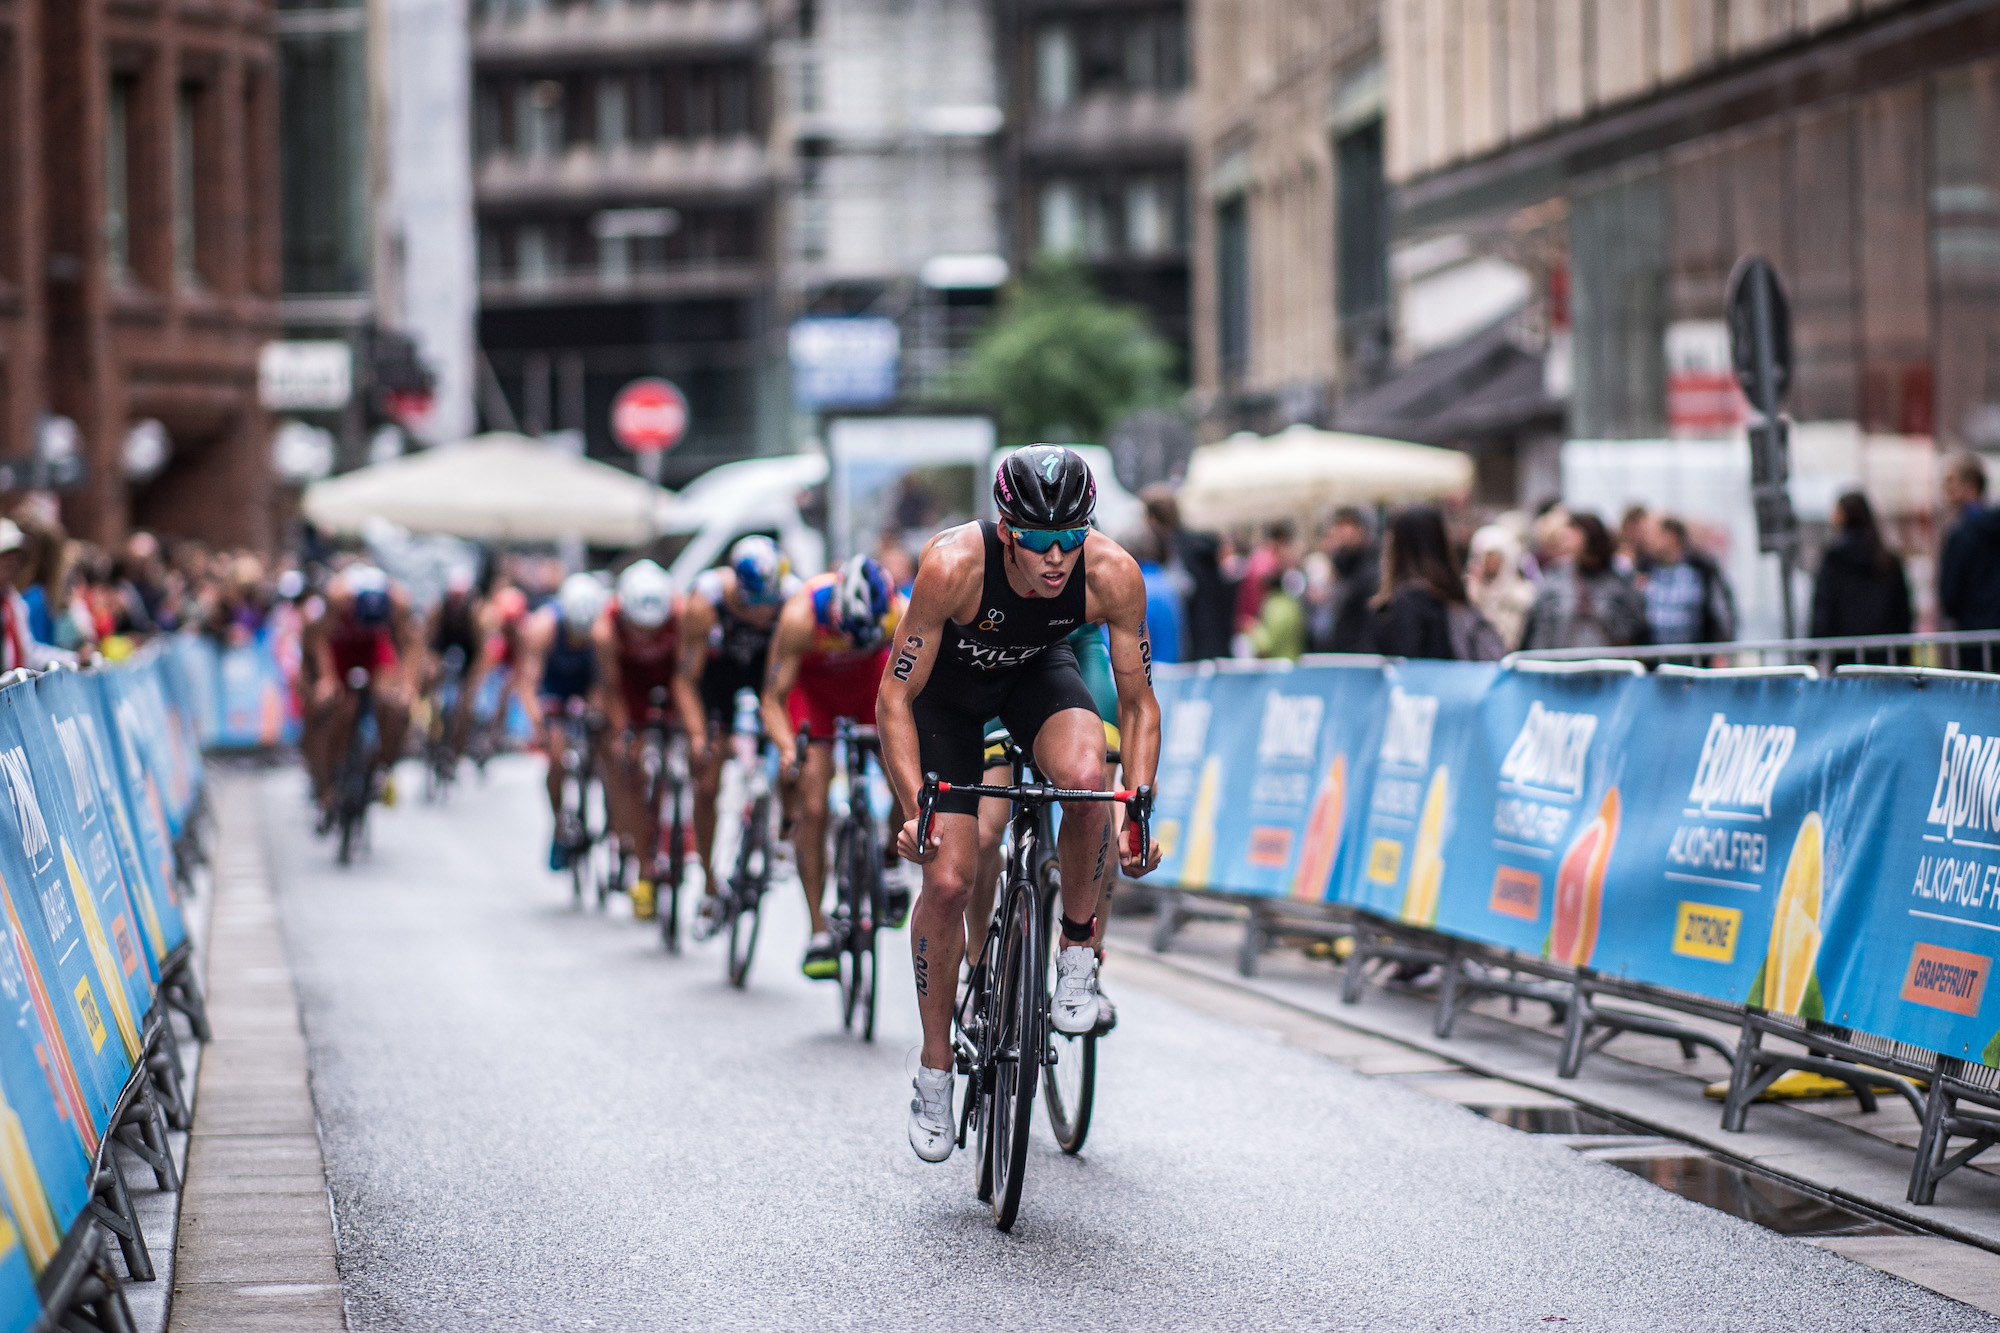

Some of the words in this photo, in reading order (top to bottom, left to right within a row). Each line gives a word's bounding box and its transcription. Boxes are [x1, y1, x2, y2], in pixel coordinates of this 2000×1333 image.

[1047, 618, 1074, 626] 2XU
[1665, 825, 1768, 873] ALKOHOLFREI
[1913, 957, 1978, 999] GRAPEFRUIT
